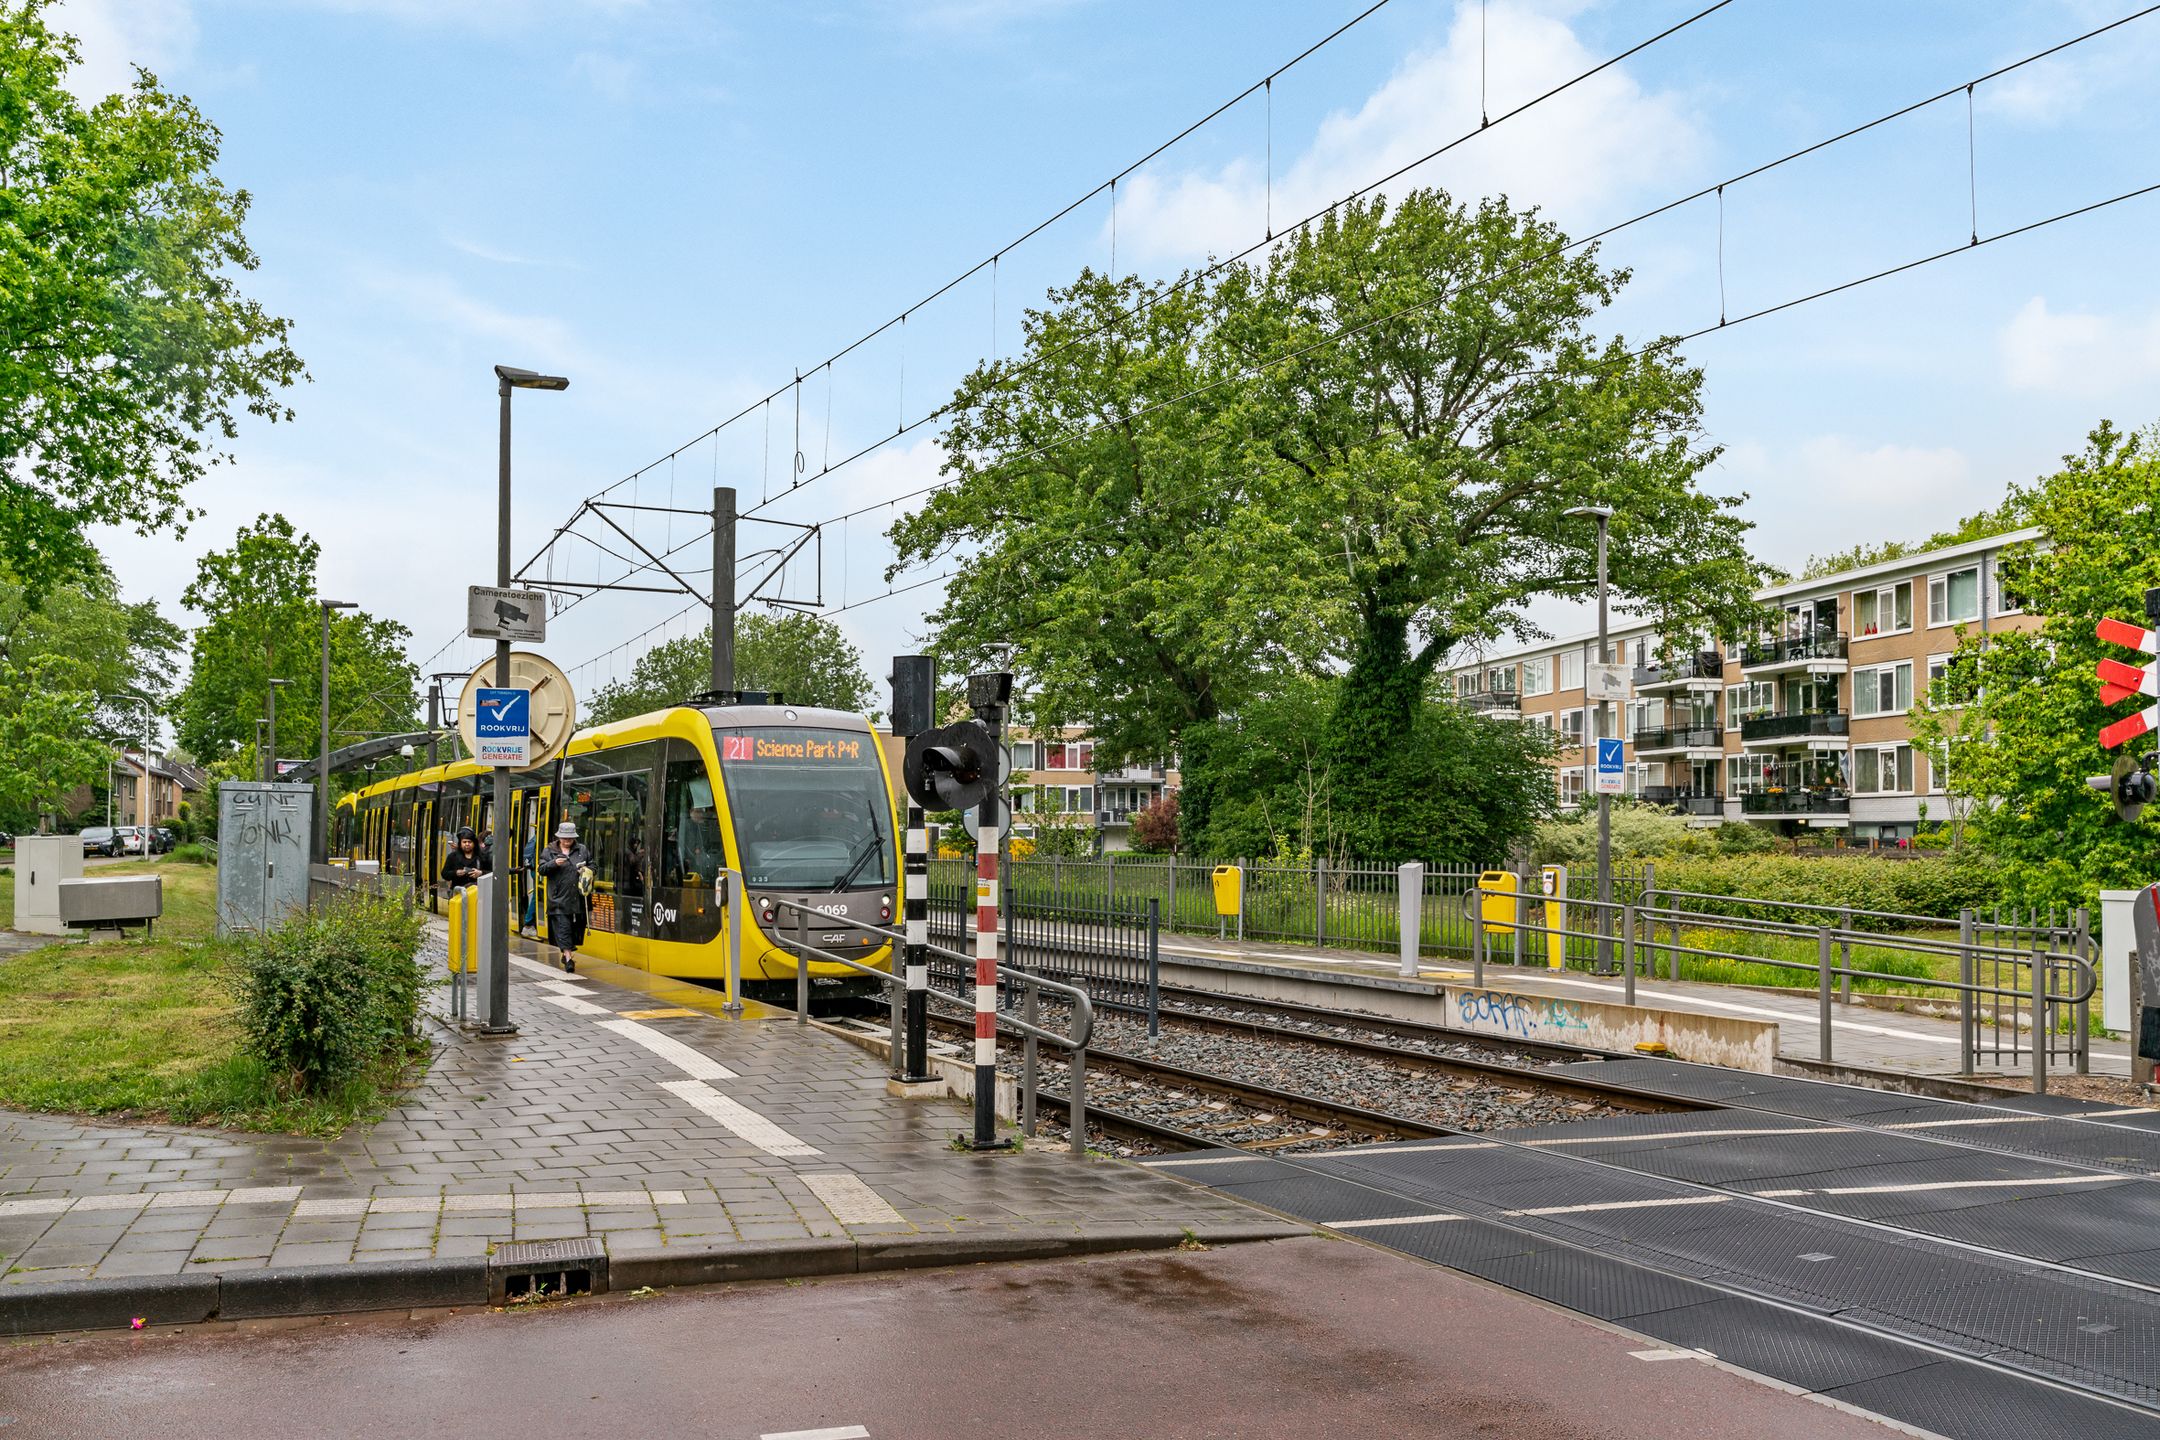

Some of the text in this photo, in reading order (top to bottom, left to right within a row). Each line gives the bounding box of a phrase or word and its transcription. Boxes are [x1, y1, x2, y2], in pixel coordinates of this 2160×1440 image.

[473, 587, 543, 602] Cameratoezicht
[480, 724, 525, 732] ROOKVRIJ
[482, 745, 523, 753] ROOKVRIJE
[730, 737, 746, 760] 21
[757, 738, 859, 759] Science Park P+R
[482, 753, 523, 761] GENERATIE
[816, 904, 848, 916] 6069
[822, 934, 846, 943] CAF
